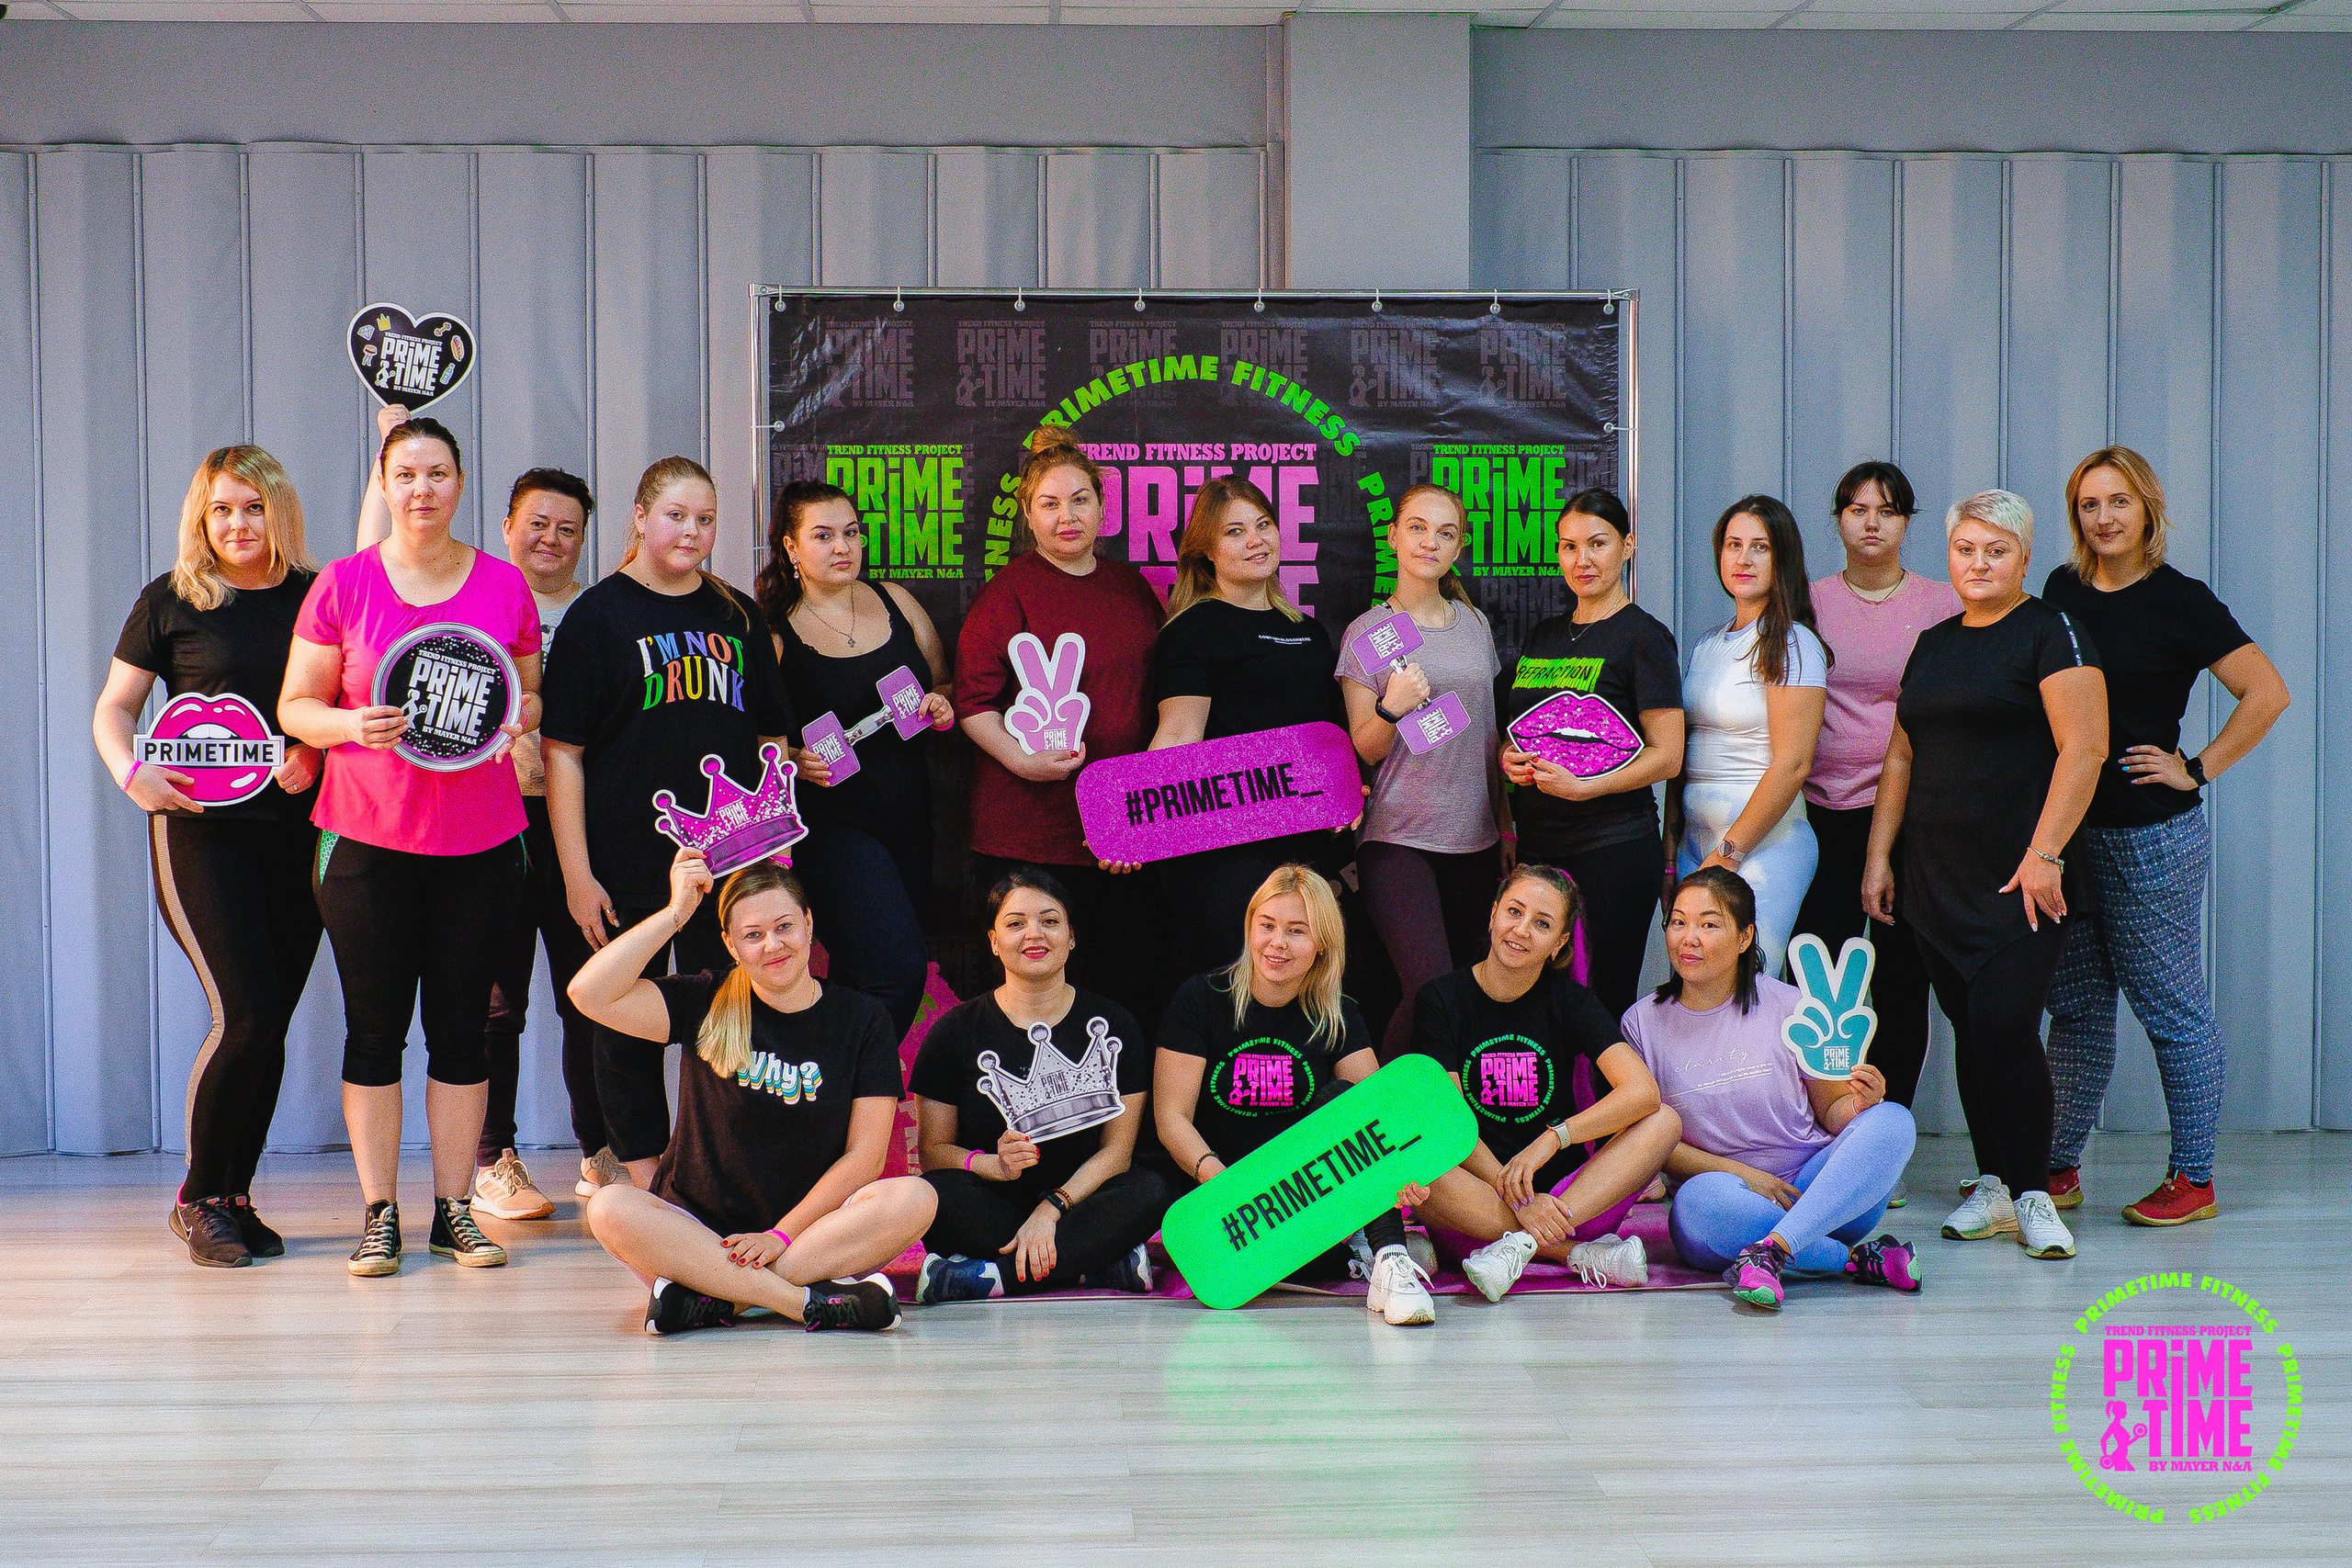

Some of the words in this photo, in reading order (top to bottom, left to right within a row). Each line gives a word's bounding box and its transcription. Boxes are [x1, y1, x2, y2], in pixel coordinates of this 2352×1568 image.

[1022, 355, 1218, 450] RIMETIME
[1231, 360, 1361, 457] FITNESS
[828, 445, 864, 455] TREND
[867, 445, 911, 455] FITNESS
[914, 445, 963, 456] PROJECT
[1079, 443, 1139, 461] TREND
[1146, 443, 1226, 461] FITNESS
[1231, 443, 1317, 464] PROJECT
[1433, 445, 1469, 454] TREND
[1472, 445, 1515, 454] FITNESS
[1518, 445, 1564, 456] PROJECT
[869, 569, 886, 579] BY
[889, 569, 933, 579] MAYER
[936, 569, 964, 579] N&A
[1473, 567, 1490, 577] BY
[1492, 567, 1535, 577] MAYER
[1538, 567, 1564, 577] N&A
[419, 649, 441, 660] TREND
[441, 655, 467, 668] FITNESS
[468, 661, 496, 676] PROJECT
[637, 632, 680, 678] I'M
[684, 631, 744, 676] NOT
[1518, 665, 1593, 682] REFRACTION
[643, 656, 745, 713] DRUNK
[434, 728, 459, 741] MAYER
[461, 735, 478, 746] N&A
[144, 742, 274, 762] PRIMETIME
[1125, 762, 1324, 827] #PRIMETIME_
[1220, 1118, 1422, 1253] #PRIMETIME_
